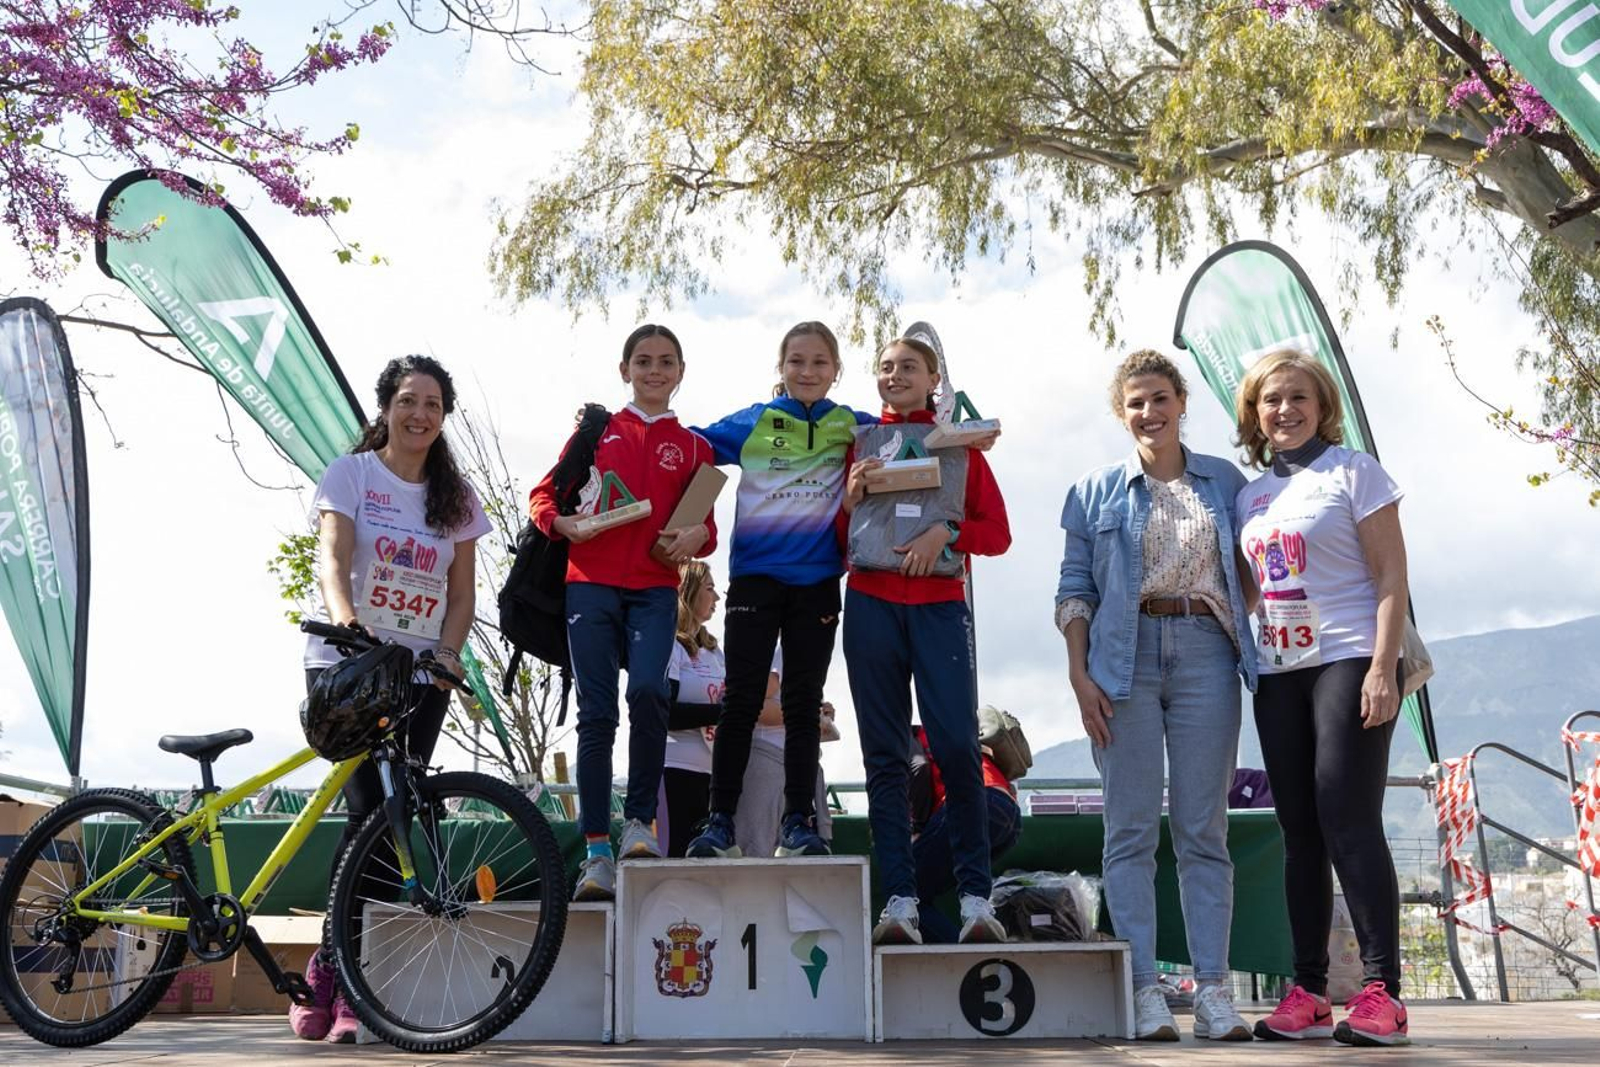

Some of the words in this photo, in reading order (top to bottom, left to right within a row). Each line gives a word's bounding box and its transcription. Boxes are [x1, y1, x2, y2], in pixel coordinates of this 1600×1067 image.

[370, 585, 439, 618] 5347
[1262, 625, 1314, 649] 5813
[741, 923, 758, 990] 1
[976, 964, 1017, 1032] 3
